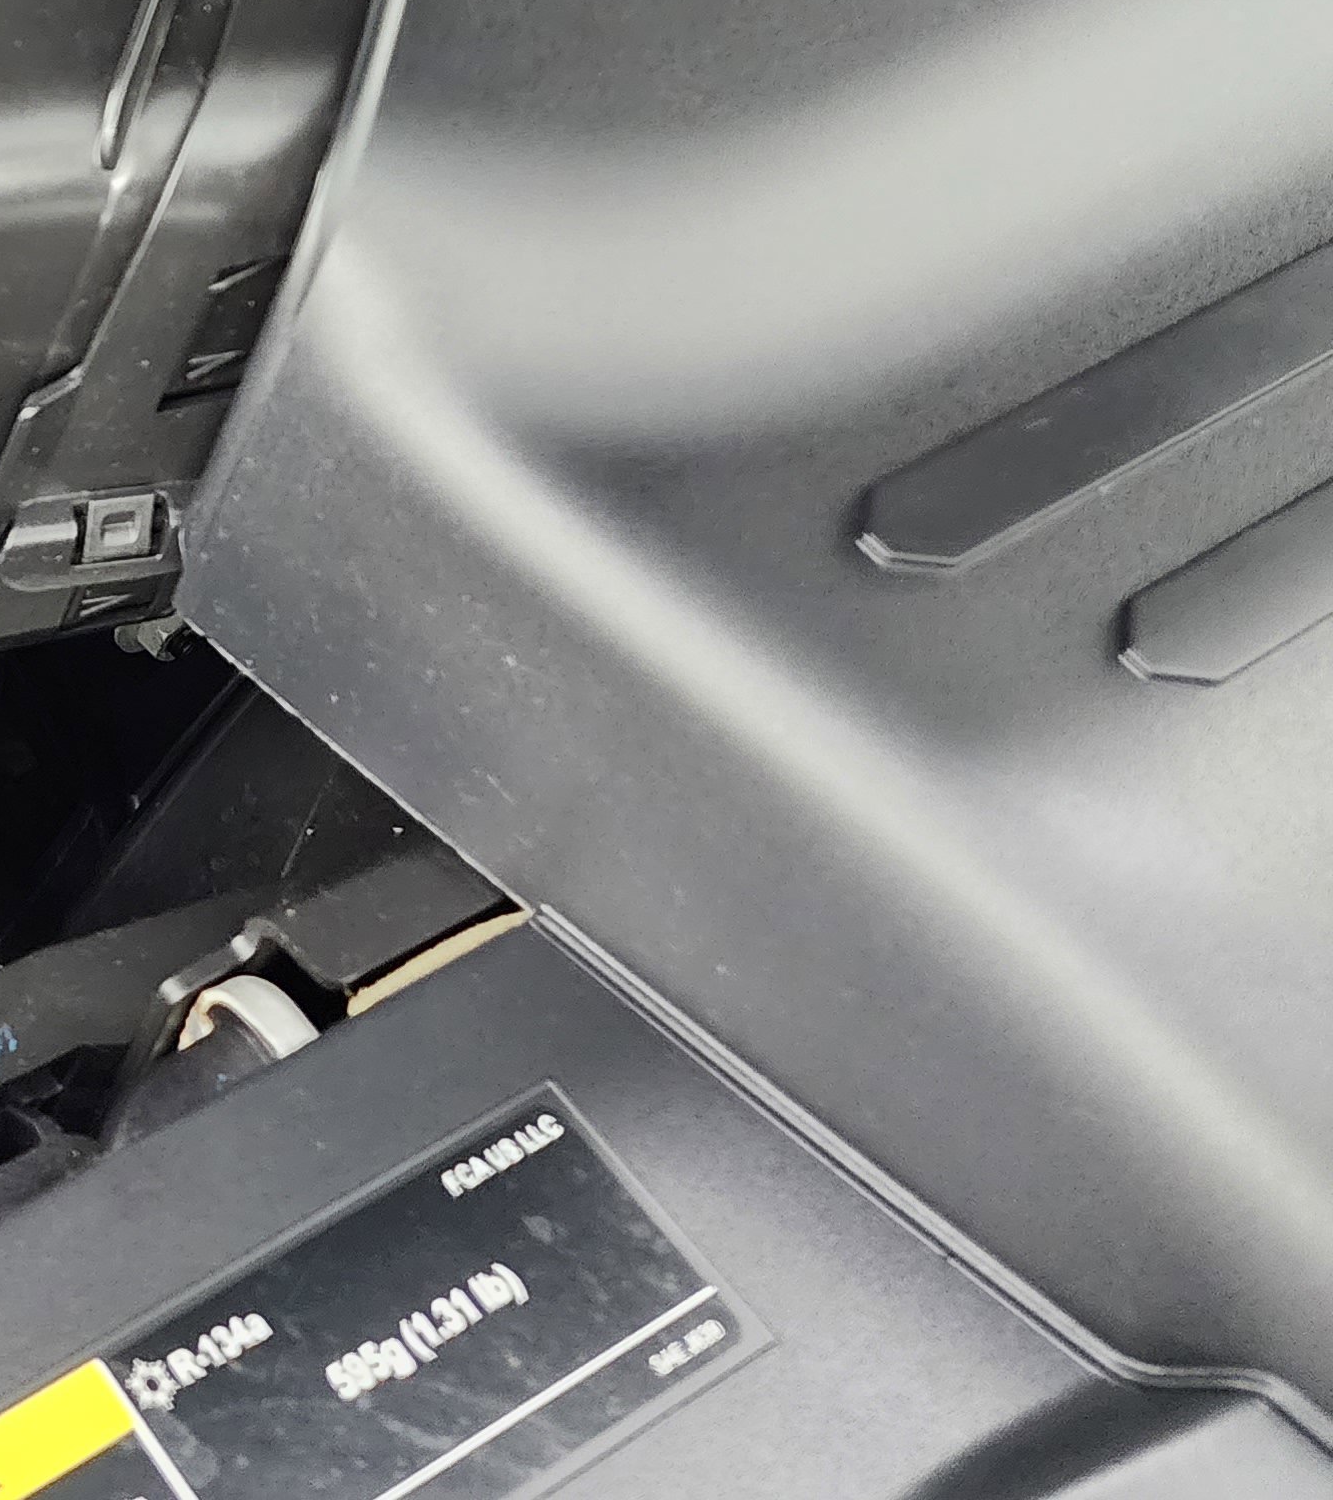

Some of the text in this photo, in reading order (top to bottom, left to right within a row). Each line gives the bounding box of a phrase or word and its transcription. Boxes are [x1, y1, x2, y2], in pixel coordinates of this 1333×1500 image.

[440, 1113, 566, 1198] FCA US LLC
[166, 1312, 274, 1387] R-134a
[325, 1261, 529, 1400] 595g (1.31 lb)
